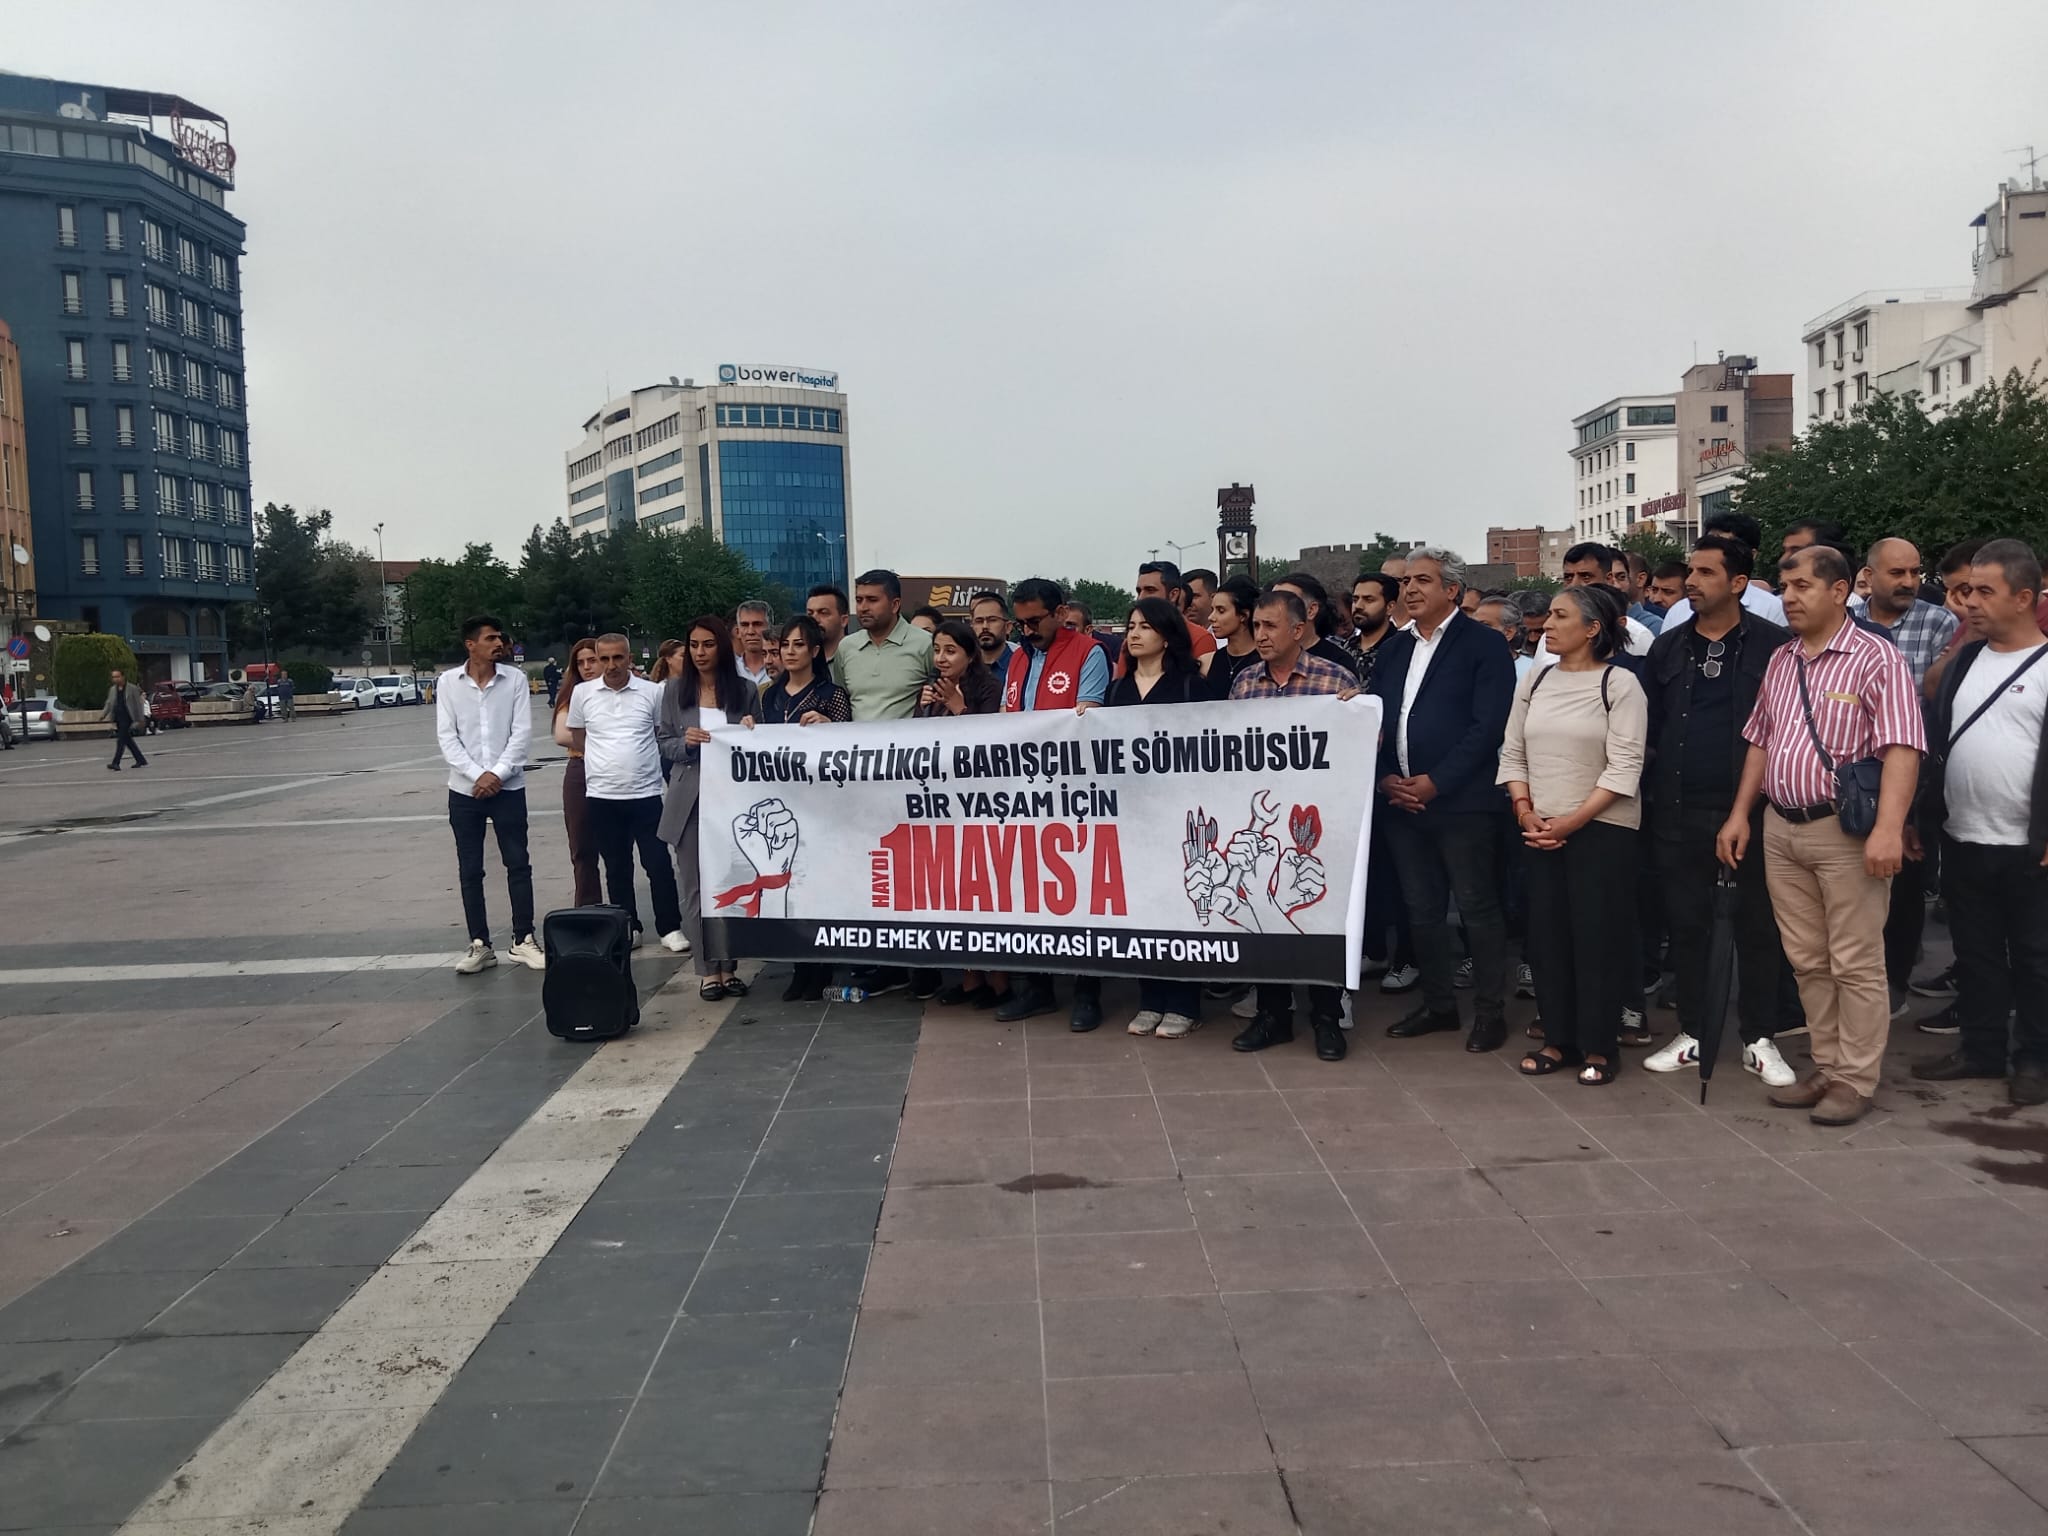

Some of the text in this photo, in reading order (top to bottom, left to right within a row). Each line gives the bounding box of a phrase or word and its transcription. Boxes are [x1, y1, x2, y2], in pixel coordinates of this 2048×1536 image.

[738, 365, 836, 388] bower hospital
[730, 724, 1330, 788] ÖZGÜR, EŞİTLİKÇİ, BARIŞÇIL VE SÖMÜRÜSÜZ
[905, 782, 1119, 824] BİR YAŞAM İÇİN
[868, 850, 890, 908] HAYDİ
[880, 822, 1128, 916] 1 MAYIS'A
[814, 926, 1240, 963] AMED EMEK VE DEMOKRASİ PLATFORMU
